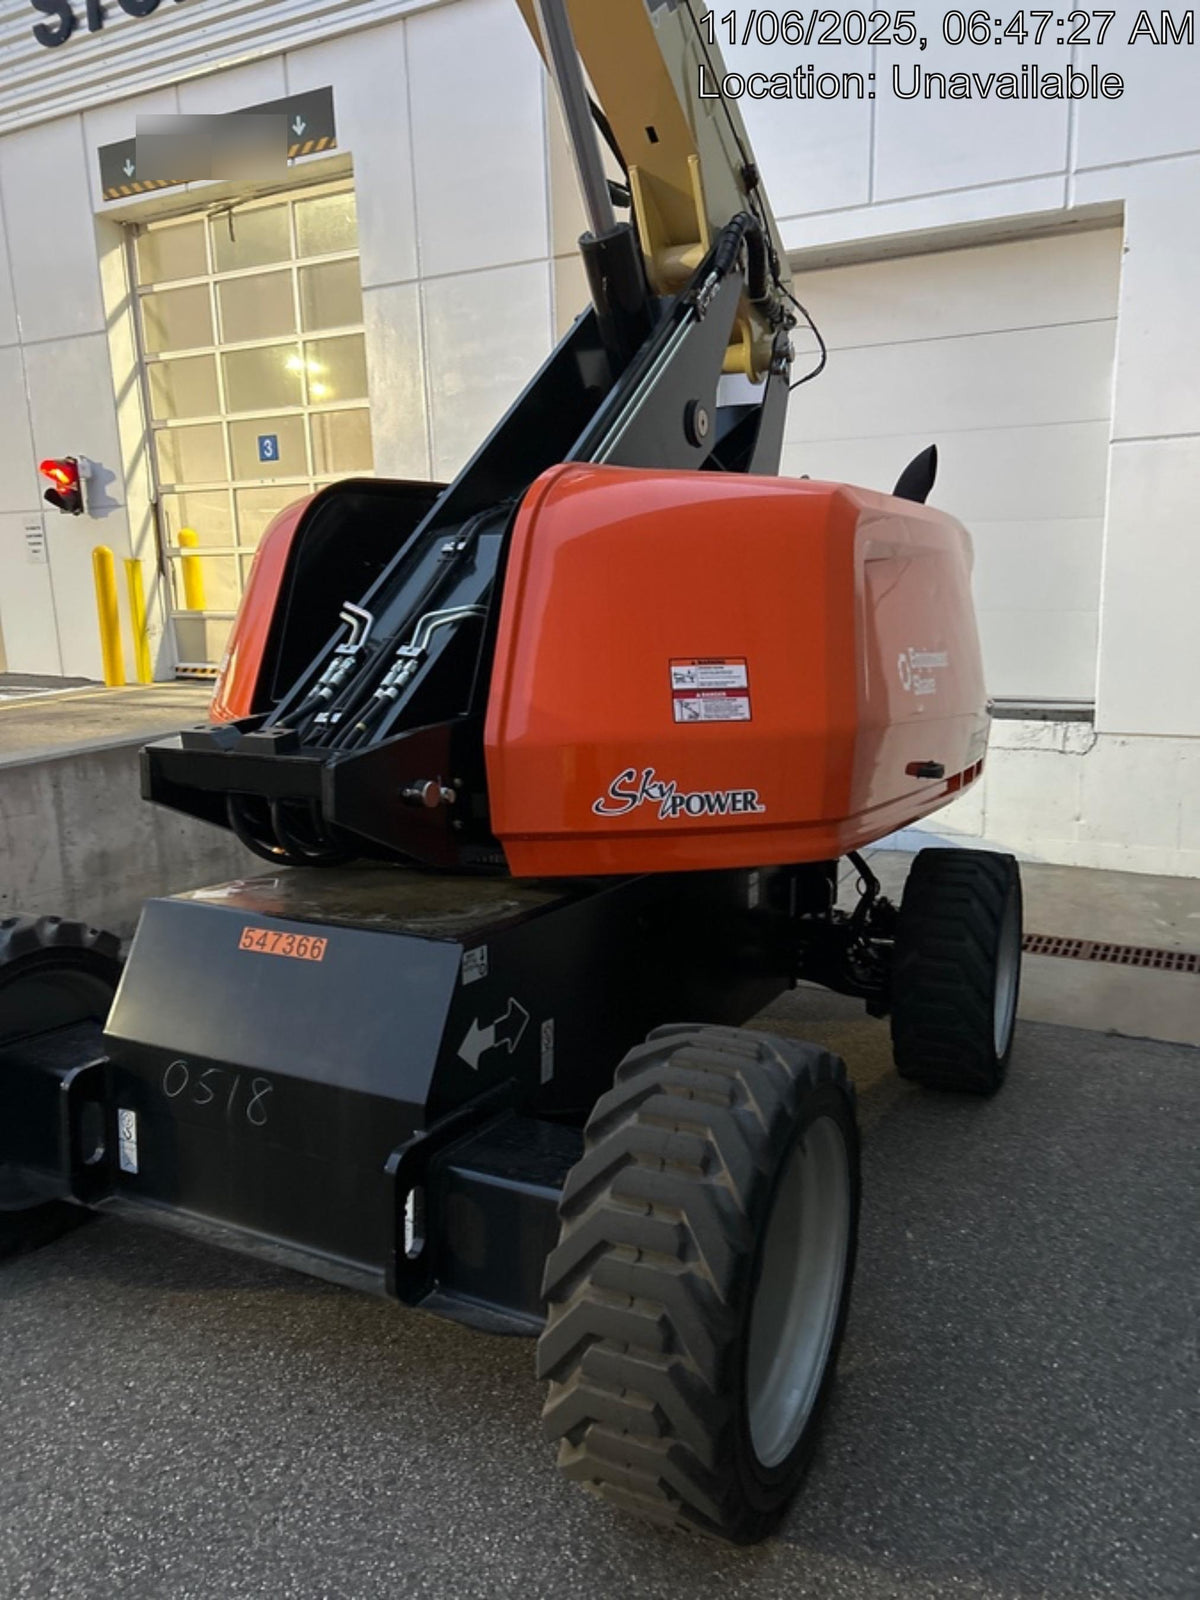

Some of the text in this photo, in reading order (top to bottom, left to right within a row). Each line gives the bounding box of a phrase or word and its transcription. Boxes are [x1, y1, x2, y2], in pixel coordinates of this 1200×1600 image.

[263, 438, 273, 458] 3
[241, 928, 324, 959] 547366
[162, 1059, 274, 1127] 0518
